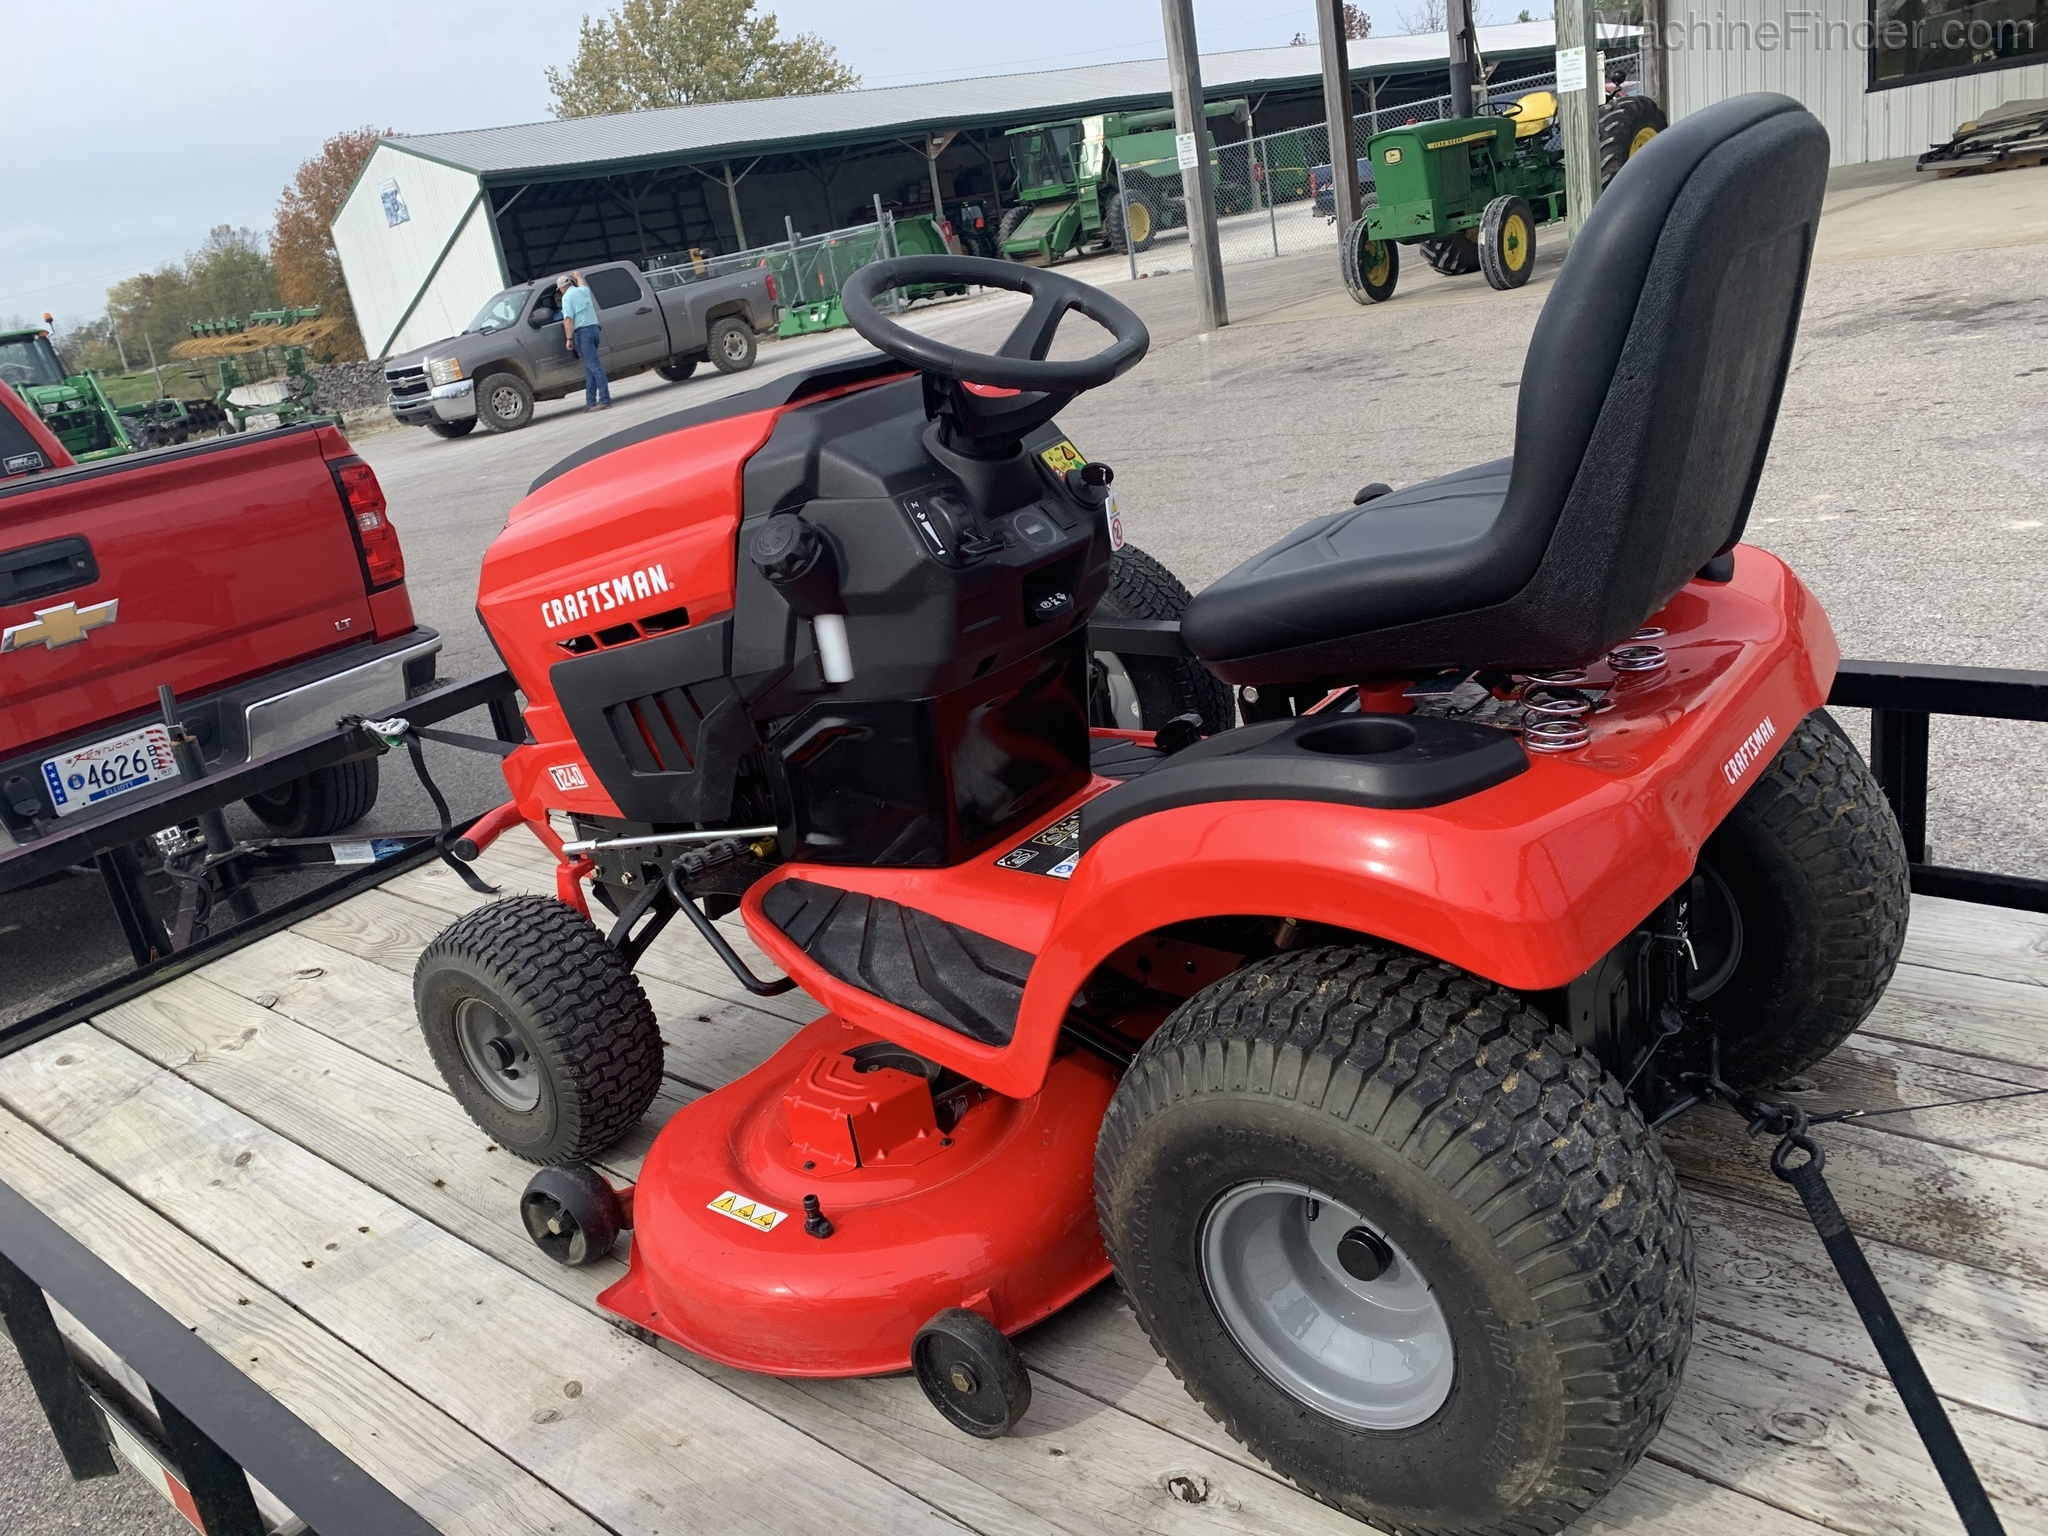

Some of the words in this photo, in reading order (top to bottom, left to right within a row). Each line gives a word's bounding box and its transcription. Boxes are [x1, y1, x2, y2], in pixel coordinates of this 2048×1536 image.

[541, 563, 669, 629] CRAFTSMAN
[334, 617, 352, 631] LT
[88, 749, 147, 788] 4626
[1723, 715, 1776, 785] CRAFTSMAN
[550, 764, 586, 788] T240
